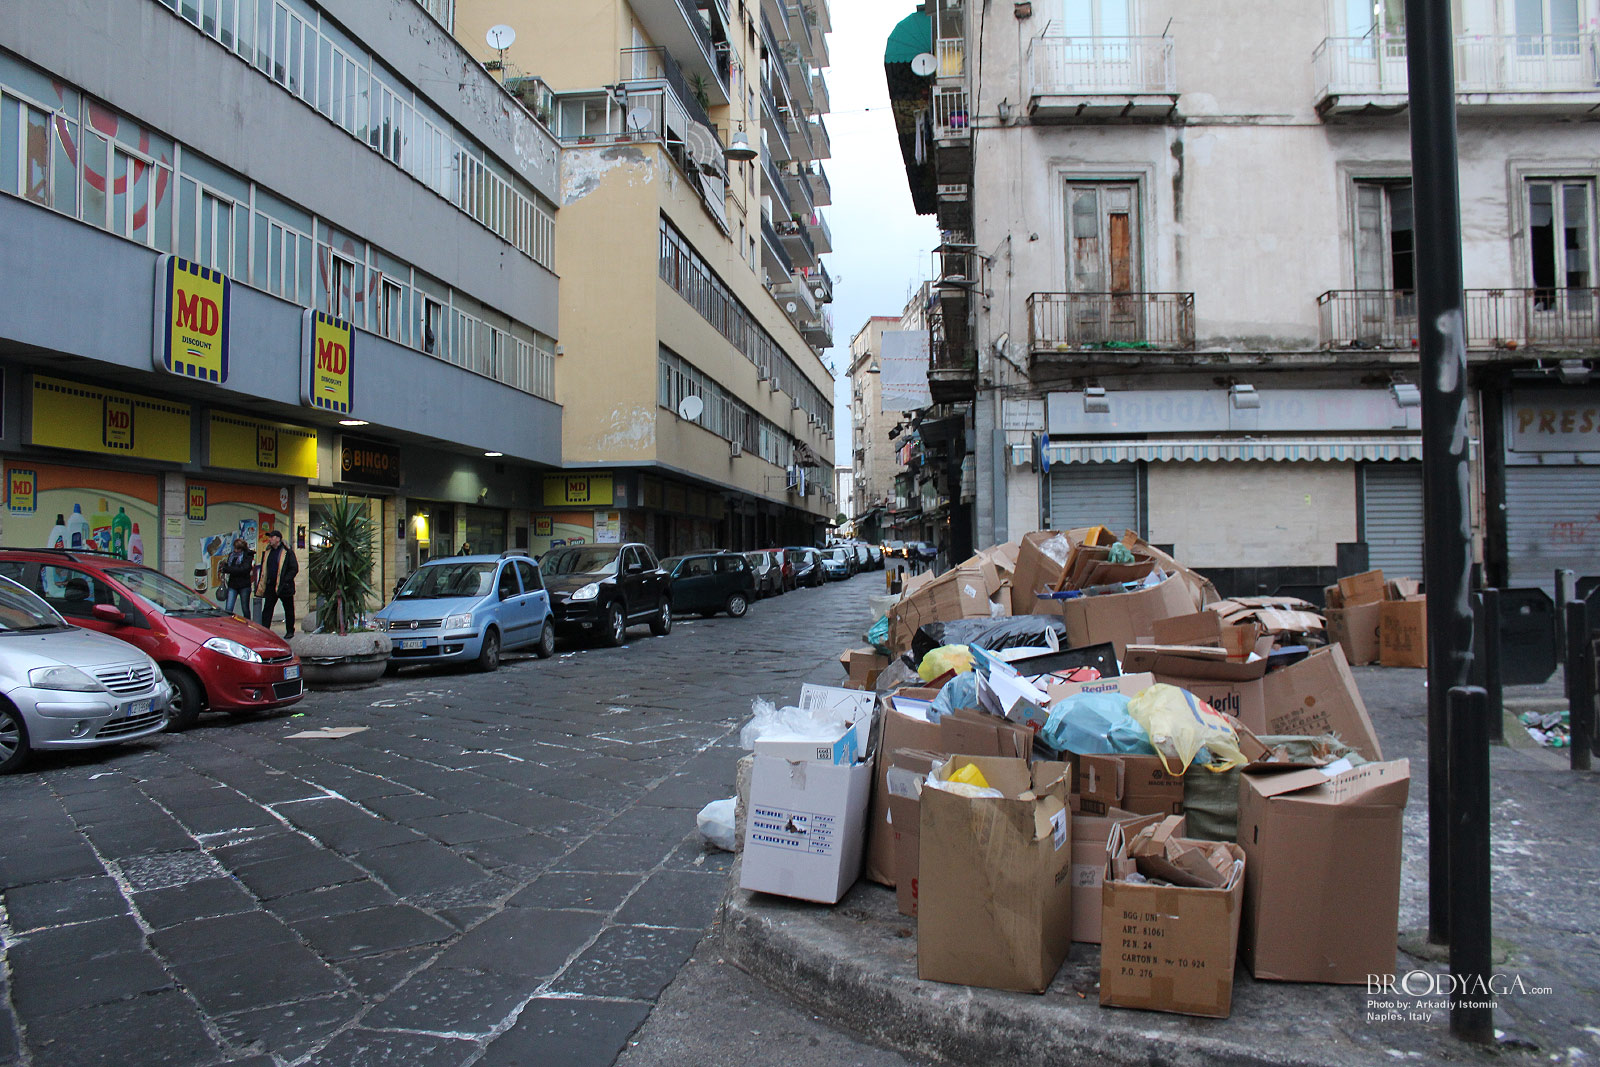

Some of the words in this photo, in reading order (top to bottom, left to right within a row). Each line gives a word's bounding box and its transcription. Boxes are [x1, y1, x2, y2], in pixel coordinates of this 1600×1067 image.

[176, 288, 219, 336] MD
[181, 336, 212, 350] DISCOUNT
[317, 337, 347, 375] MD
[108, 410, 130, 429] MD
[1517, 407, 1600, 435] PRES
[260, 436, 275, 451] MD
[354, 450, 389, 470] BINGO
[13, 480, 33, 495] MD
[569, 482, 586, 492] MD
[191, 495, 204, 507] MD
[537, 521, 550, 529] MD
[1081, 682, 1119, 693] Regina
[1207, 692, 1240, 718] derly
[755, 808, 784, 819] SERIE
[753, 821, 782, 831] SERIE
[752, 833, 800, 847] CUBOTTO
[1123, 911, 1138, 920] BGG
[1143, 927, 1165, 937] 81061
[1143, 941, 1152, 950] 24
[1121, 953, 1151, 964] CARTON
[1179, 958, 1188, 967] TO
[1140, 968, 1153, 978] 276
